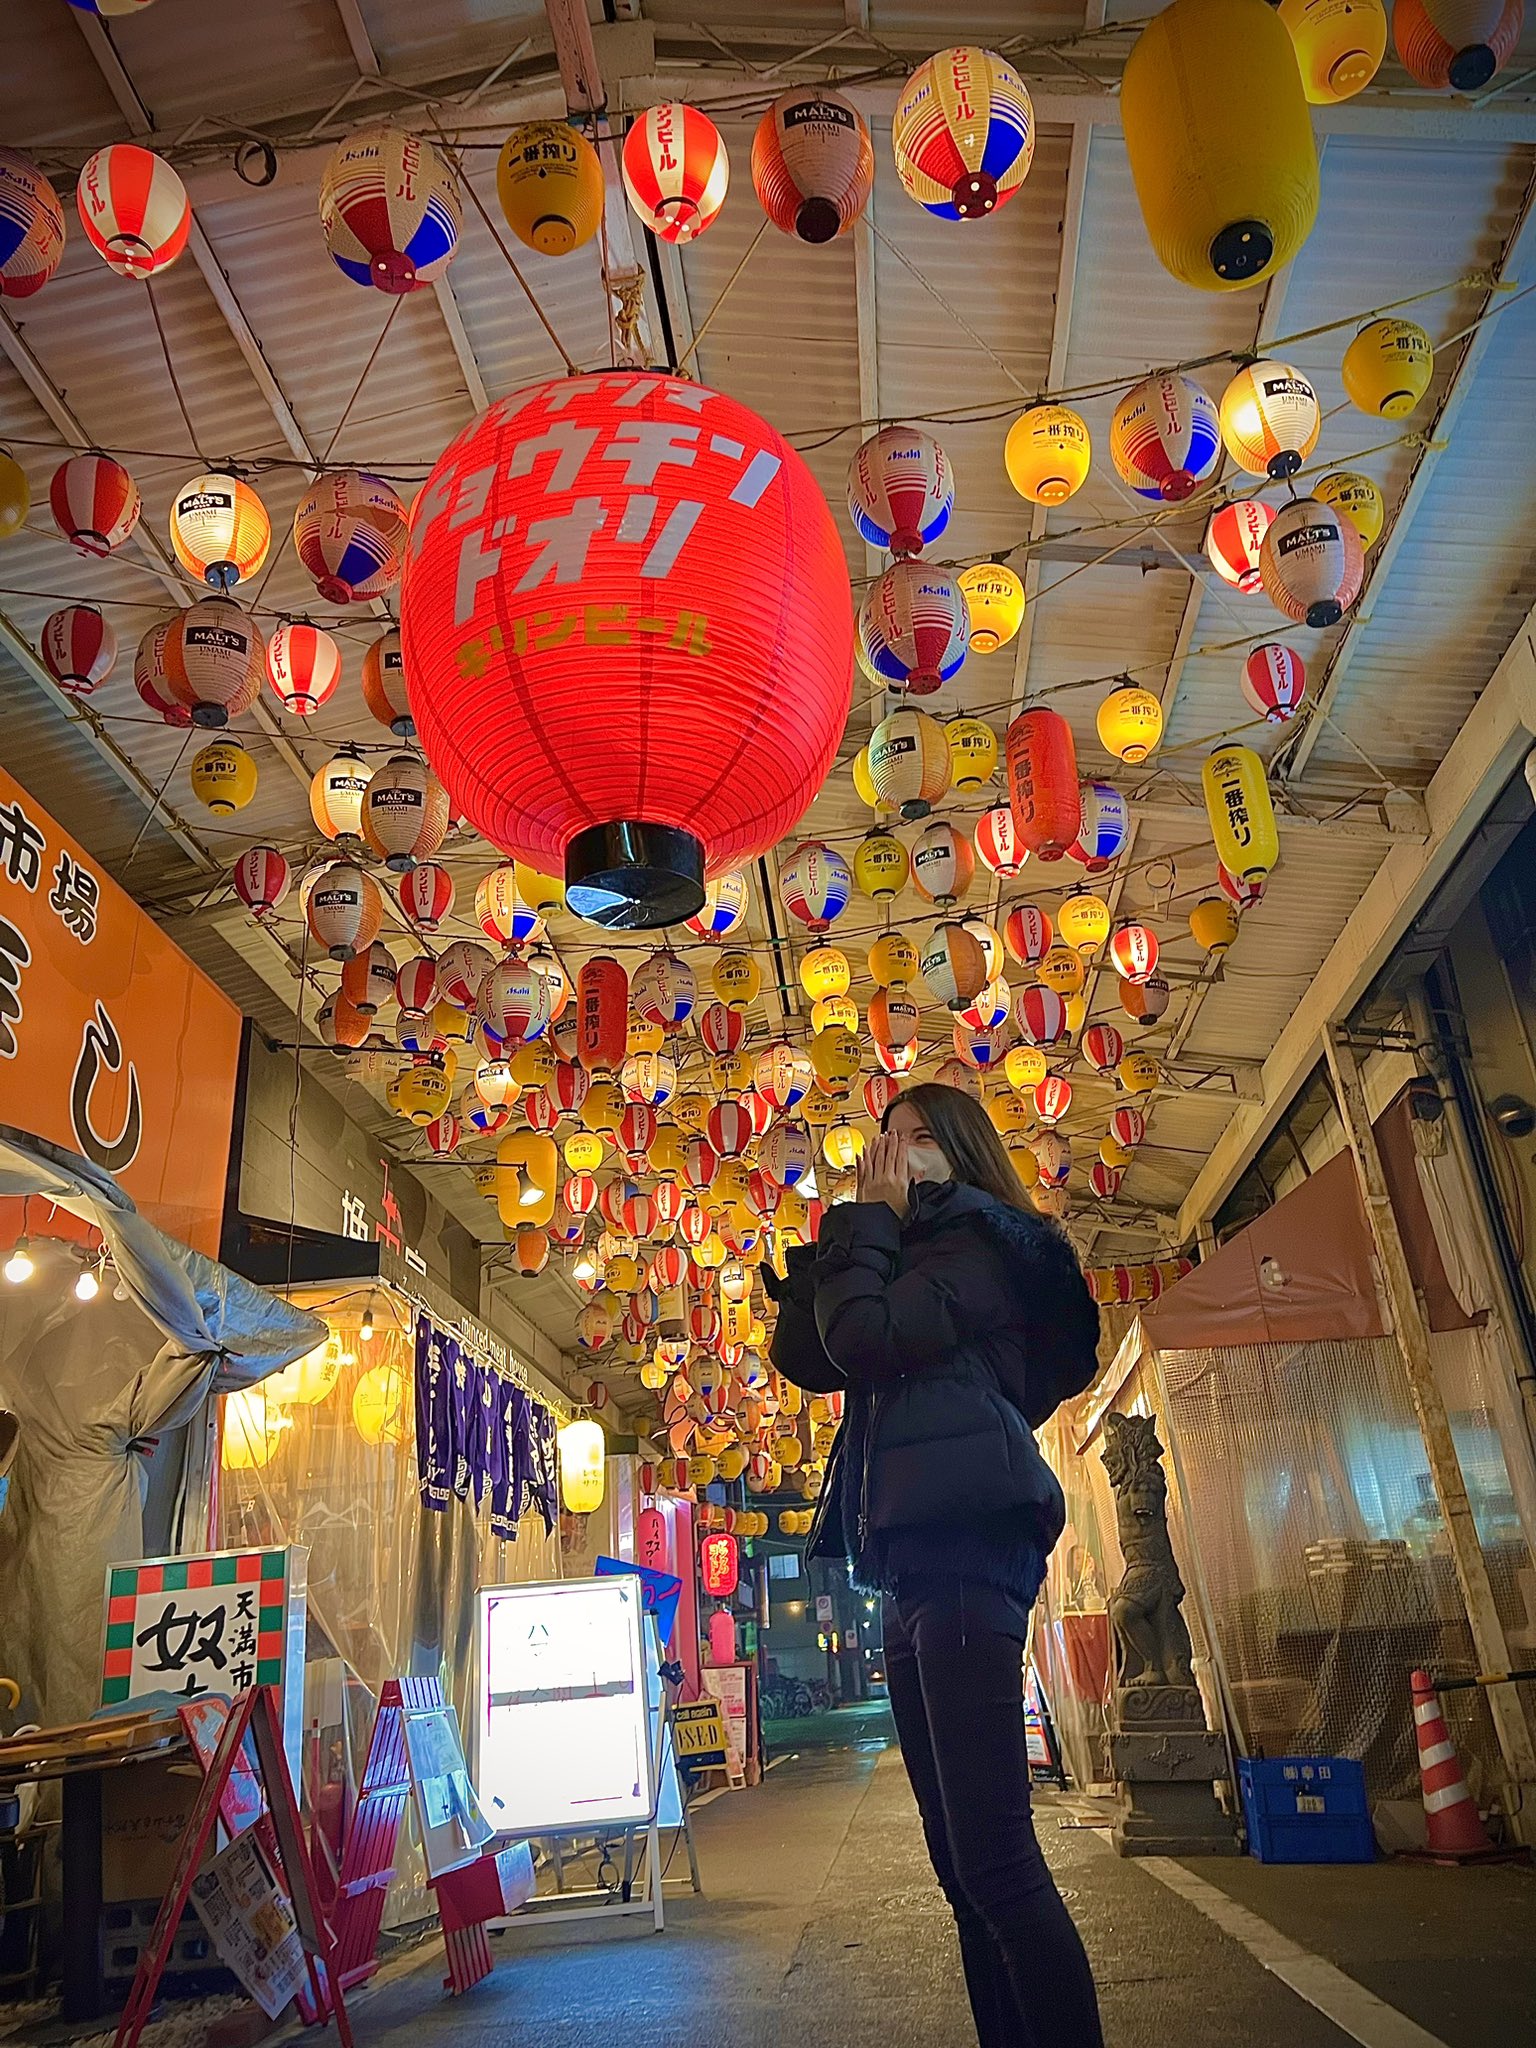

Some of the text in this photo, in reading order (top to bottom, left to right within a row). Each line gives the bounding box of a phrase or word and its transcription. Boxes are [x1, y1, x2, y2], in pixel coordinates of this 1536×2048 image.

[794, 107, 847, 122] MALT'S
[340, 146, 380, 166] Asahi
[508, 141, 578, 168] 一番搾り
[1273, 381, 1313, 396] MALT'S
[887, 449, 921, 461] Asahi
[184, 495, 225, 510] MALT'S
[1286, 529, 1331, 548] MALT'S
[454, 494, 705, 628] ドオリ
[917, 584, 950, 598] Asahi
[194, 631, 240, 648] MALT'S
[454, 604, 713, 681] キリンビール
[950, 737, 991, 750] 一番搾り
[196, 762, 237, 774] 一番搾り
[1013, 748, 1036, 824] 一番搾り
[377, 792, 415, 803] MALT'S
[1221, 778, 1251, 848] 一番搾り
[318, 892, 352, 904] MALT'S
[1072, 909, 1105, 920] 一番搾り
[505, 986, 531, 997] Asahi
[584, 988, 600, 1049] 一番搾り
[461, 1316, 529, 1384] minced meat house
[228, 1590, 258, 1693] 天満市
